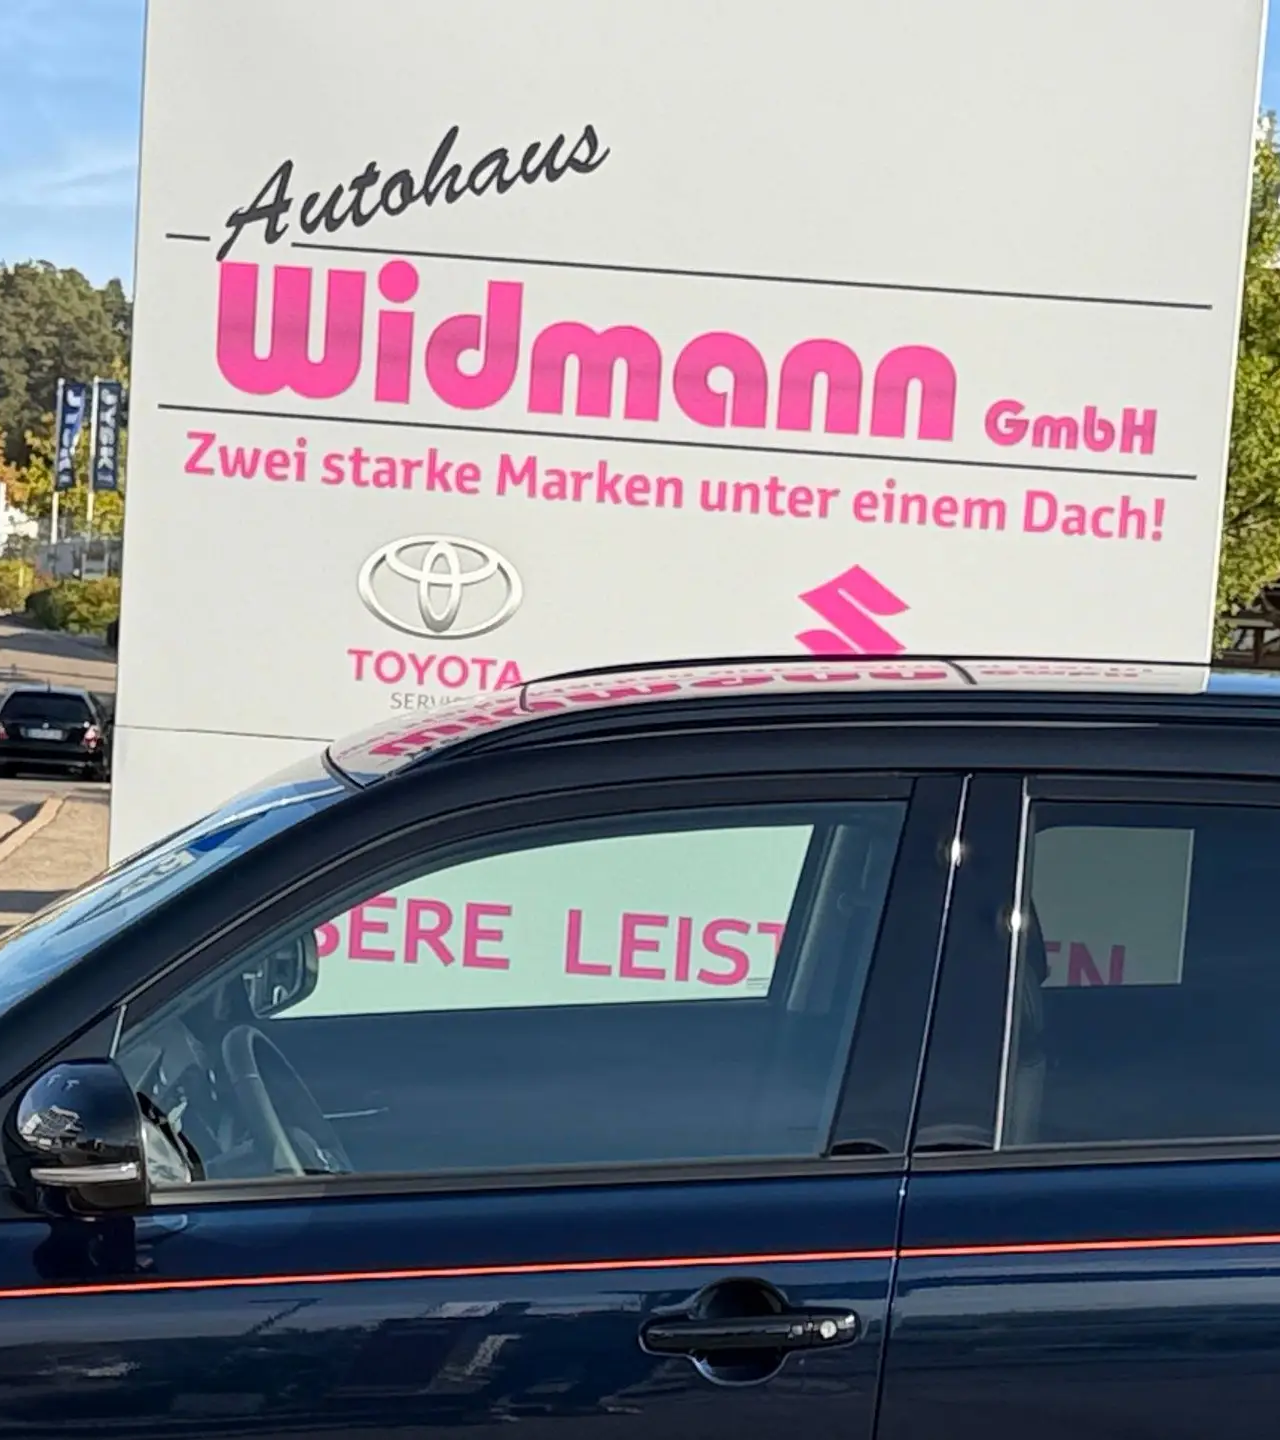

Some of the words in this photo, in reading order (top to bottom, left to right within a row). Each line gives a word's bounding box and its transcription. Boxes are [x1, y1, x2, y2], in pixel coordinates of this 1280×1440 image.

[216, 125, 611, 262] Autohaus
[216, 258, 958, 442] Widmann
[984, 398, 1158, 456] GmbH
[97, 388, 117, 471] JYSK
[184, 430, 307, 482] Zwei
[320, 446, 482, 495] starke
[495, 452, 684, 507] Marken
[699, 475, 841, 519] unter
[852, 478, 1008, 531] einem
[1022, 488, 1166, 542] Dach!
[347, 648, 523, 692] TOYOTA
[390, 691, 466, 710] SERV
